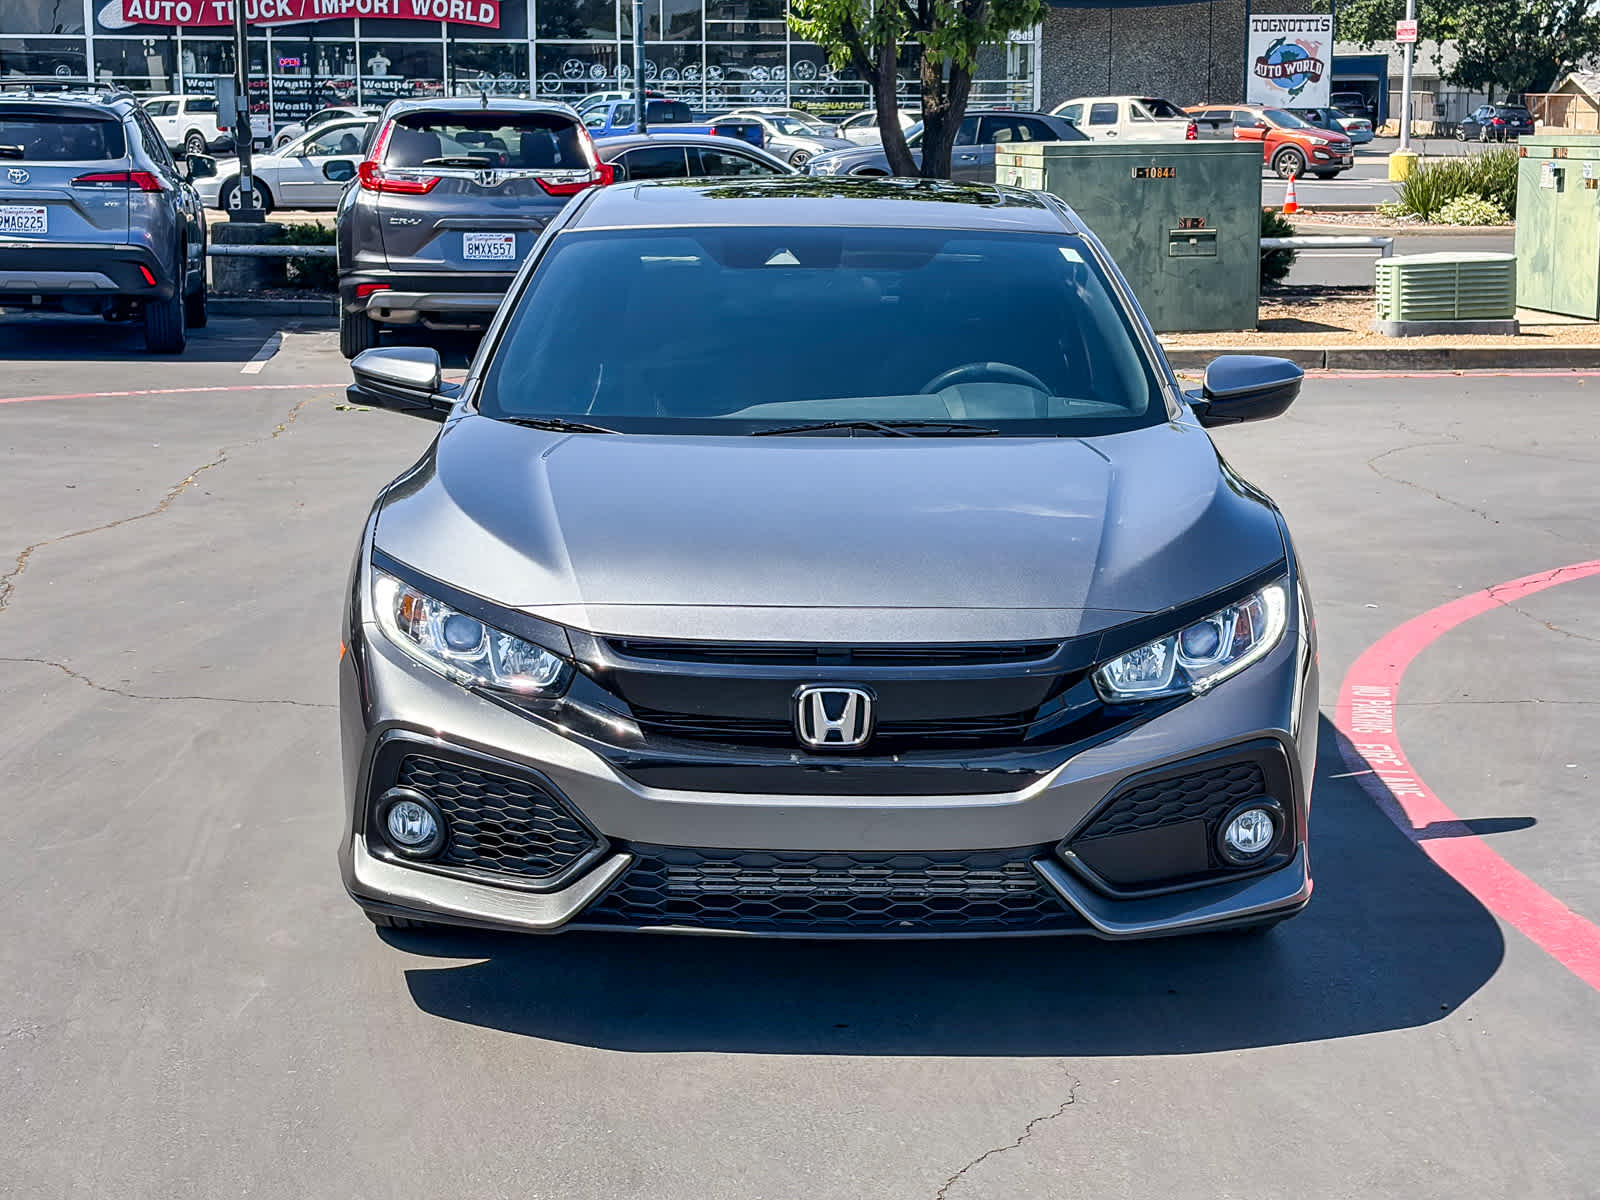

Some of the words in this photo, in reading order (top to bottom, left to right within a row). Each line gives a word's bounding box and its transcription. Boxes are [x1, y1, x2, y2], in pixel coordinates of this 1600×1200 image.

[127, 0, 192, 22] AUTO
[313, 0, 399, 14] IMPORT
[411, 0, 495, 24] WORLD
[1252, 16, 1330, 32] TOGNOTTI'S
[280, 58, 299, 66] OPEN
[1255, 63, 1282, 77] AUTO
[1284, 60, 1322, 75] WORLD
[467, 242, 512, 255] 8MXX557
